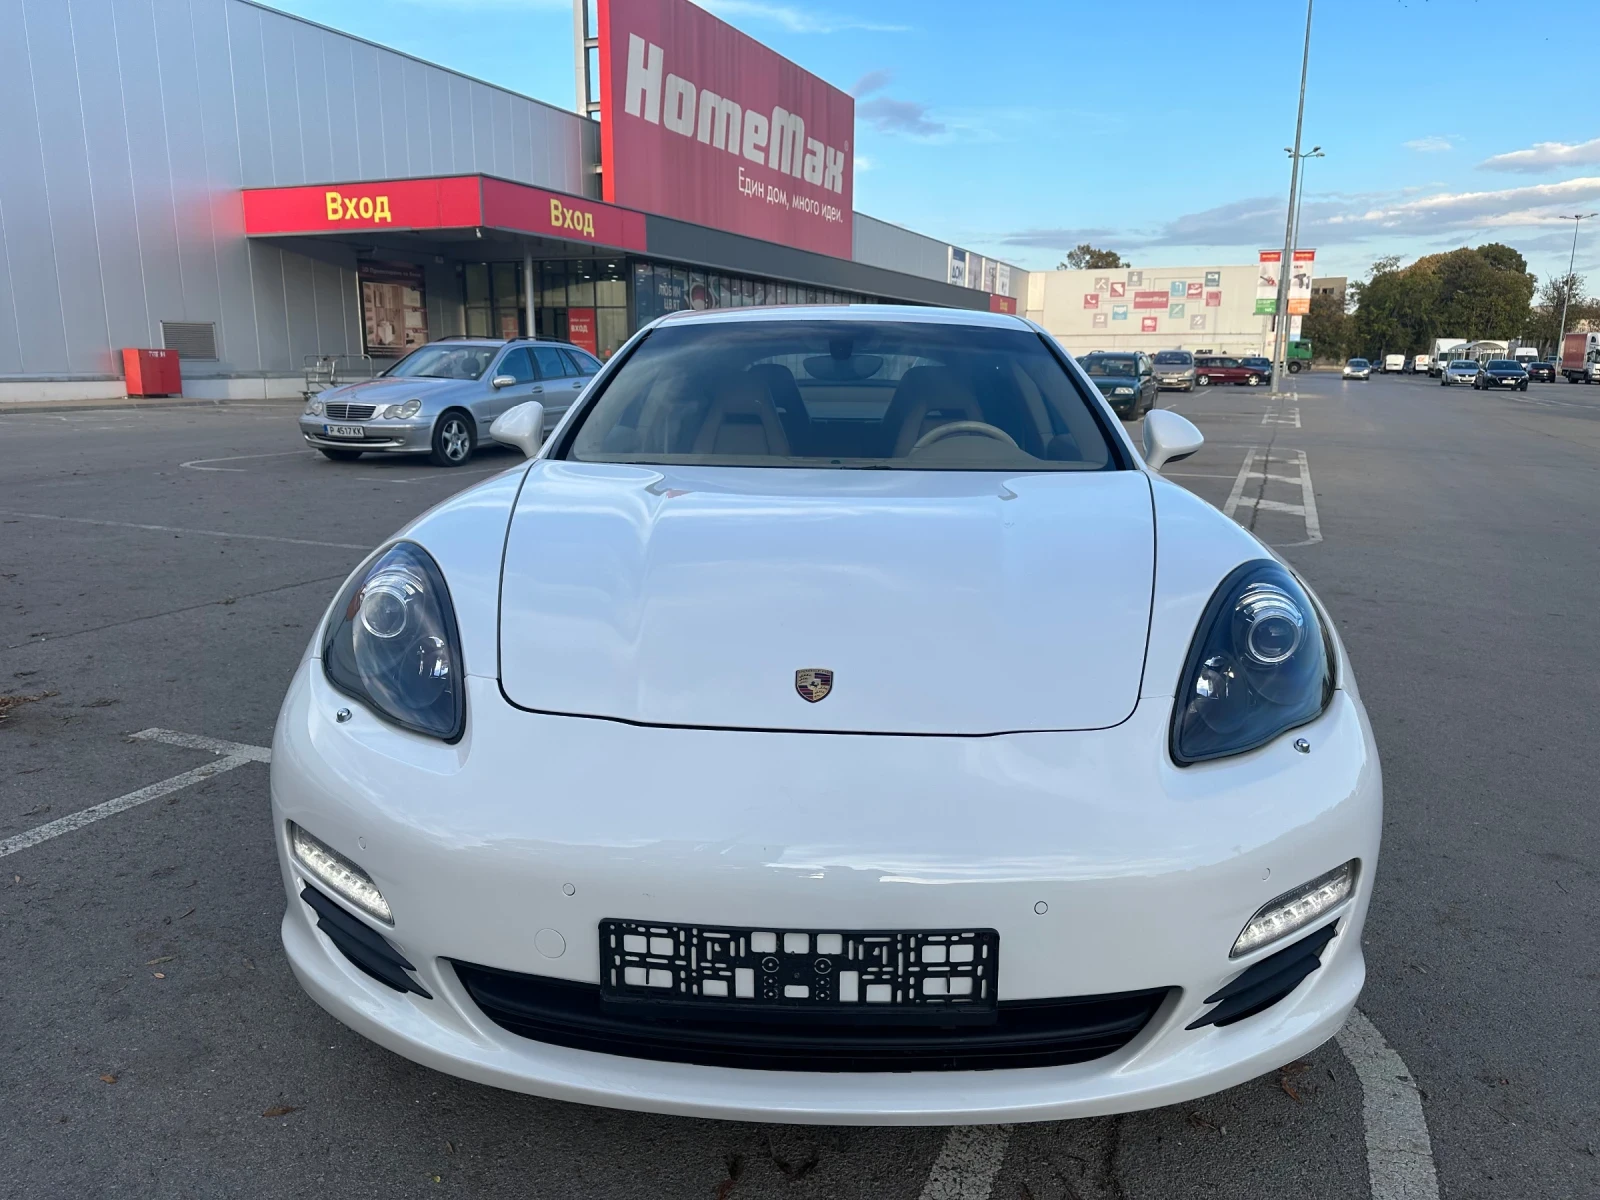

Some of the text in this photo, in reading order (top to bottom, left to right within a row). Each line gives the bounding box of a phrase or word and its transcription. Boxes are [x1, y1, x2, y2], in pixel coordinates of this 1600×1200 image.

[624, 32, 845, 195] HomeMax
[325, 191, 392, 223] Вход
[738, 166, 765, 198] Един
[766, 185, 790, 211] дом,
[791, 194, 820, 216] много
[549, 198, 595, 238] Вход
